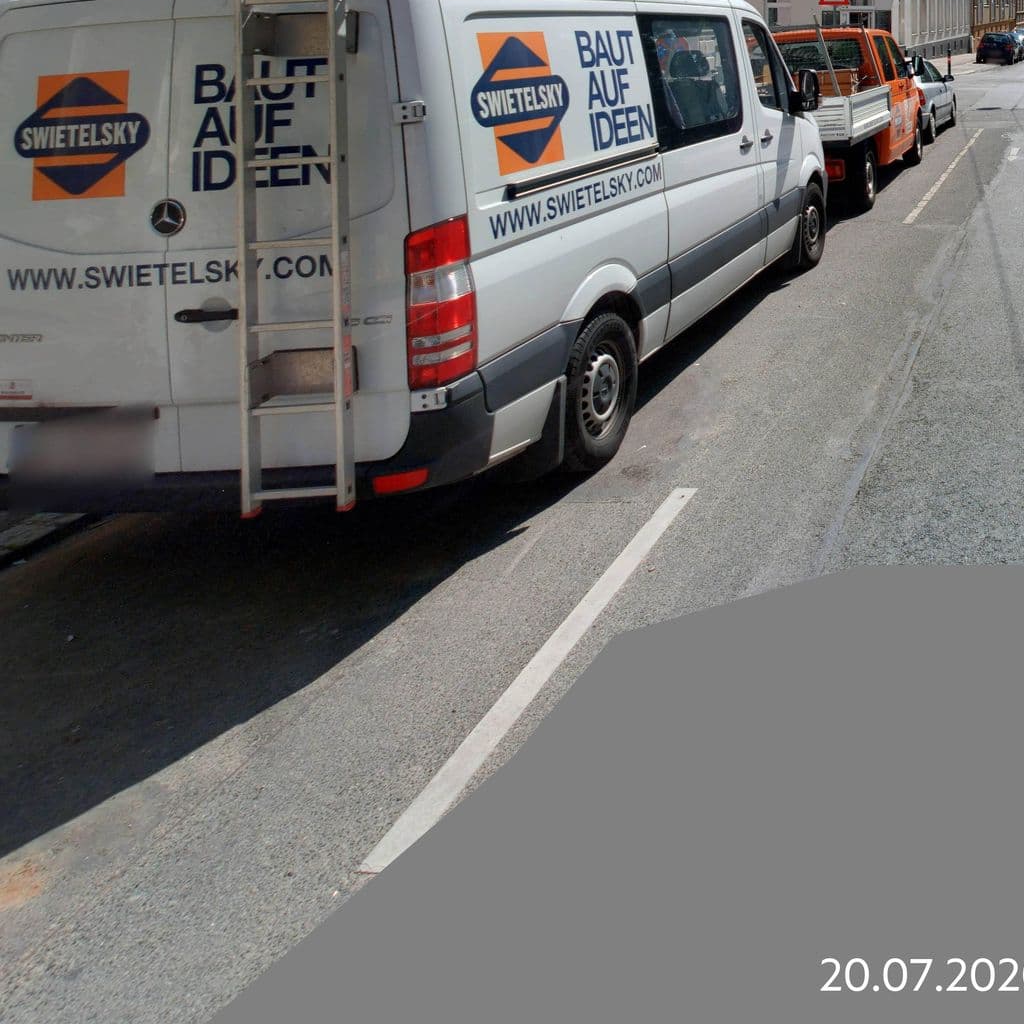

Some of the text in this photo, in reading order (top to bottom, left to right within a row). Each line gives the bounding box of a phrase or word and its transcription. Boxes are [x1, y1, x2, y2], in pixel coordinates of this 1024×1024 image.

[574, 30, 635, 69] BAUT
[476, 82, 564, 119] SWIETELSKY
[588, 68, 631, 110] AUF
[20, 120, 141, 151] SWIETELSKY
[193, 102, 295, 148] AUF
[588, 104, 655, 152] IDEEN
[489, 162, 663, 240] WWW.SWIETELSKY.COM
[7, 254, 334, 291] WWW.SWIETELSK.COM
